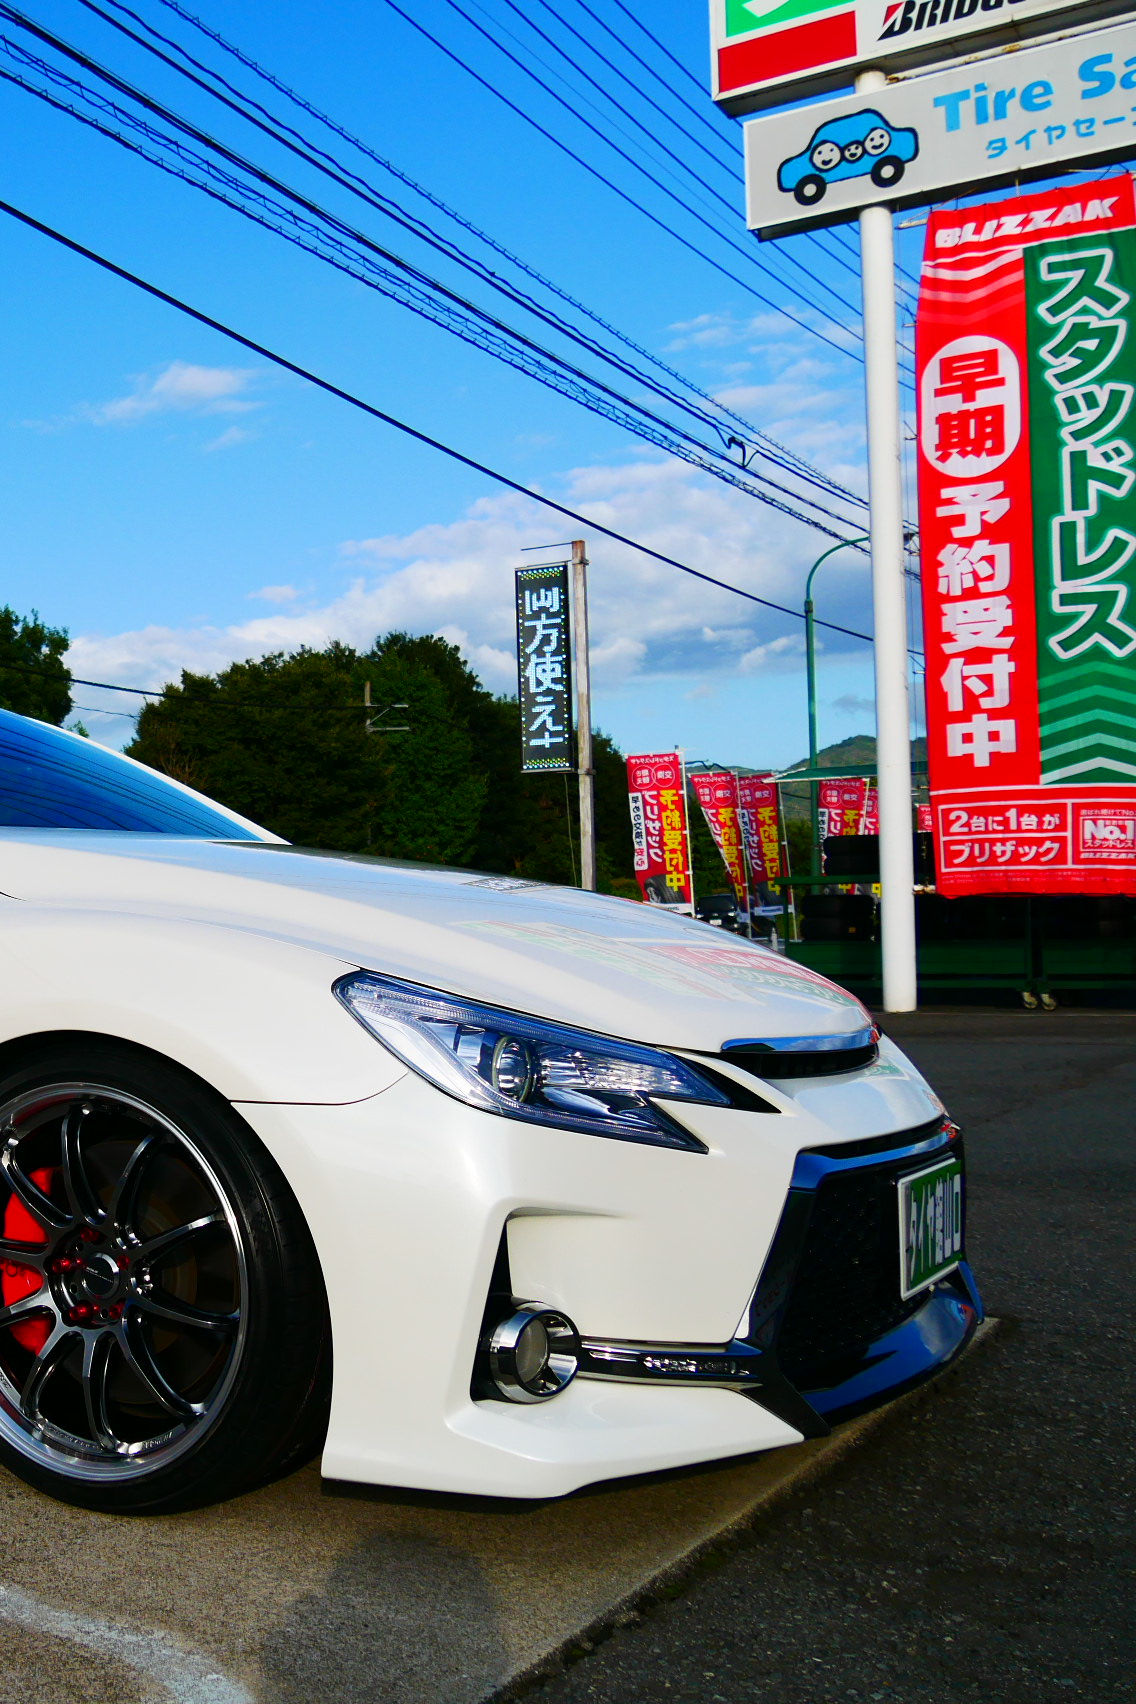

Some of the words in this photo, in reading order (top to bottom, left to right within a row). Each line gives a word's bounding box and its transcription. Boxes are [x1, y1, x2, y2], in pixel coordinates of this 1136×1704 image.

[933, 79, 1054, 132] Tire
[986, 106, 1136, 160] タイヤセー
[935, 196, 1120, 248] BLIZZAK
[933, 348, 1006, 464] 早期
[1038, 248, 1136, 659] スタッドレス
[935, 481, 1017, 768] 予約受付中
[948, 808, 1061, 833] 2台に1台が
[1084, 820, 1134, 840] No.1
[1084, 840, 1133, 848] スタッドレス
[950, 840, 1061, 865] ブリザック
